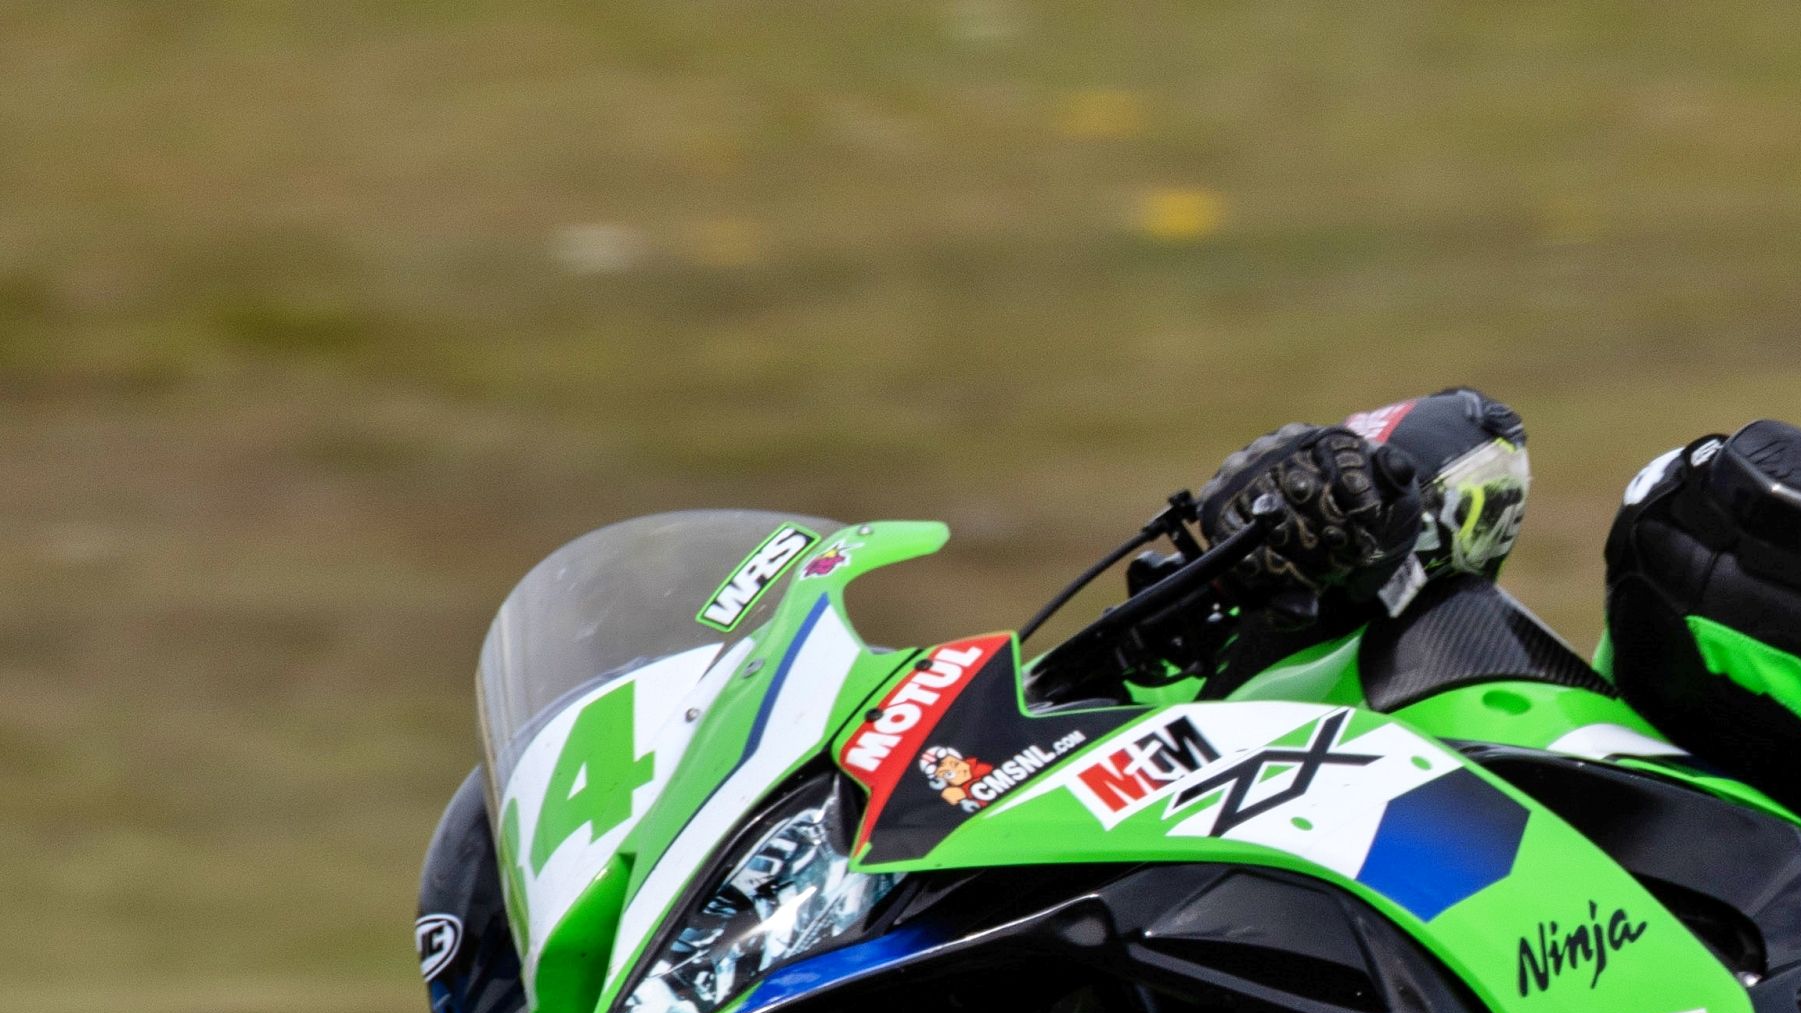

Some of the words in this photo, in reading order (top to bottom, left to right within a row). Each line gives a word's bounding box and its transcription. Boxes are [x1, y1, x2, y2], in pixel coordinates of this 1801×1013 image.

[703, 527, 811, 626] WRS
[846, 645, 984, 773] MOTUL
[1166, 705, 1388, 838] ZX
[1517, 899, 1648, 998] Ninja
